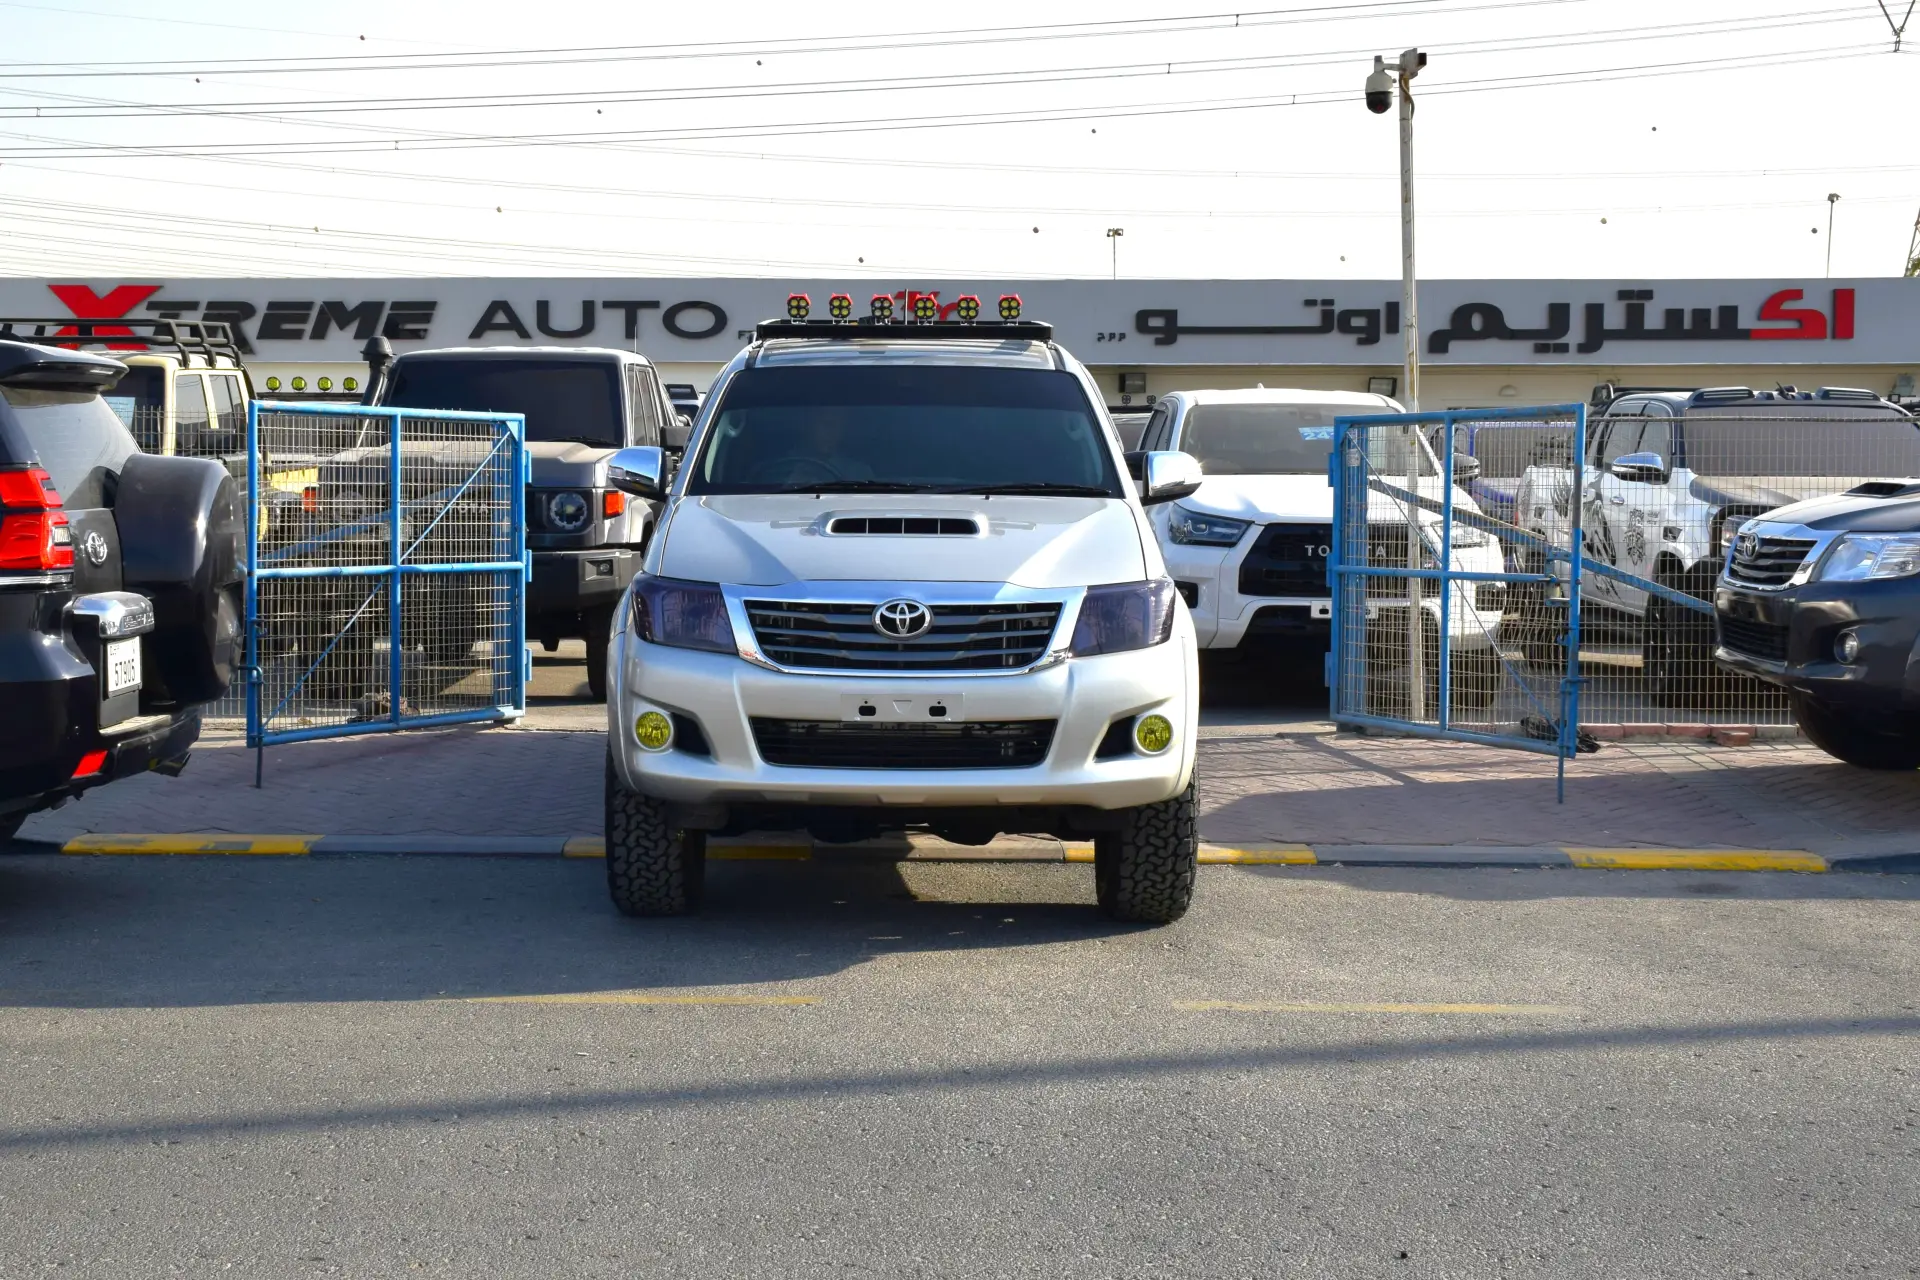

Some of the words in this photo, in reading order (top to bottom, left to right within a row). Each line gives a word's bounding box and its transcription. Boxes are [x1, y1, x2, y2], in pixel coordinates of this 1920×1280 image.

[47, 284, 438, 354] XTREME
[467, 299, 728, 340] AUTO
[1135, 298, 1400, 346] اوتو
[1428, 288, 1855, 354] اكستريم
